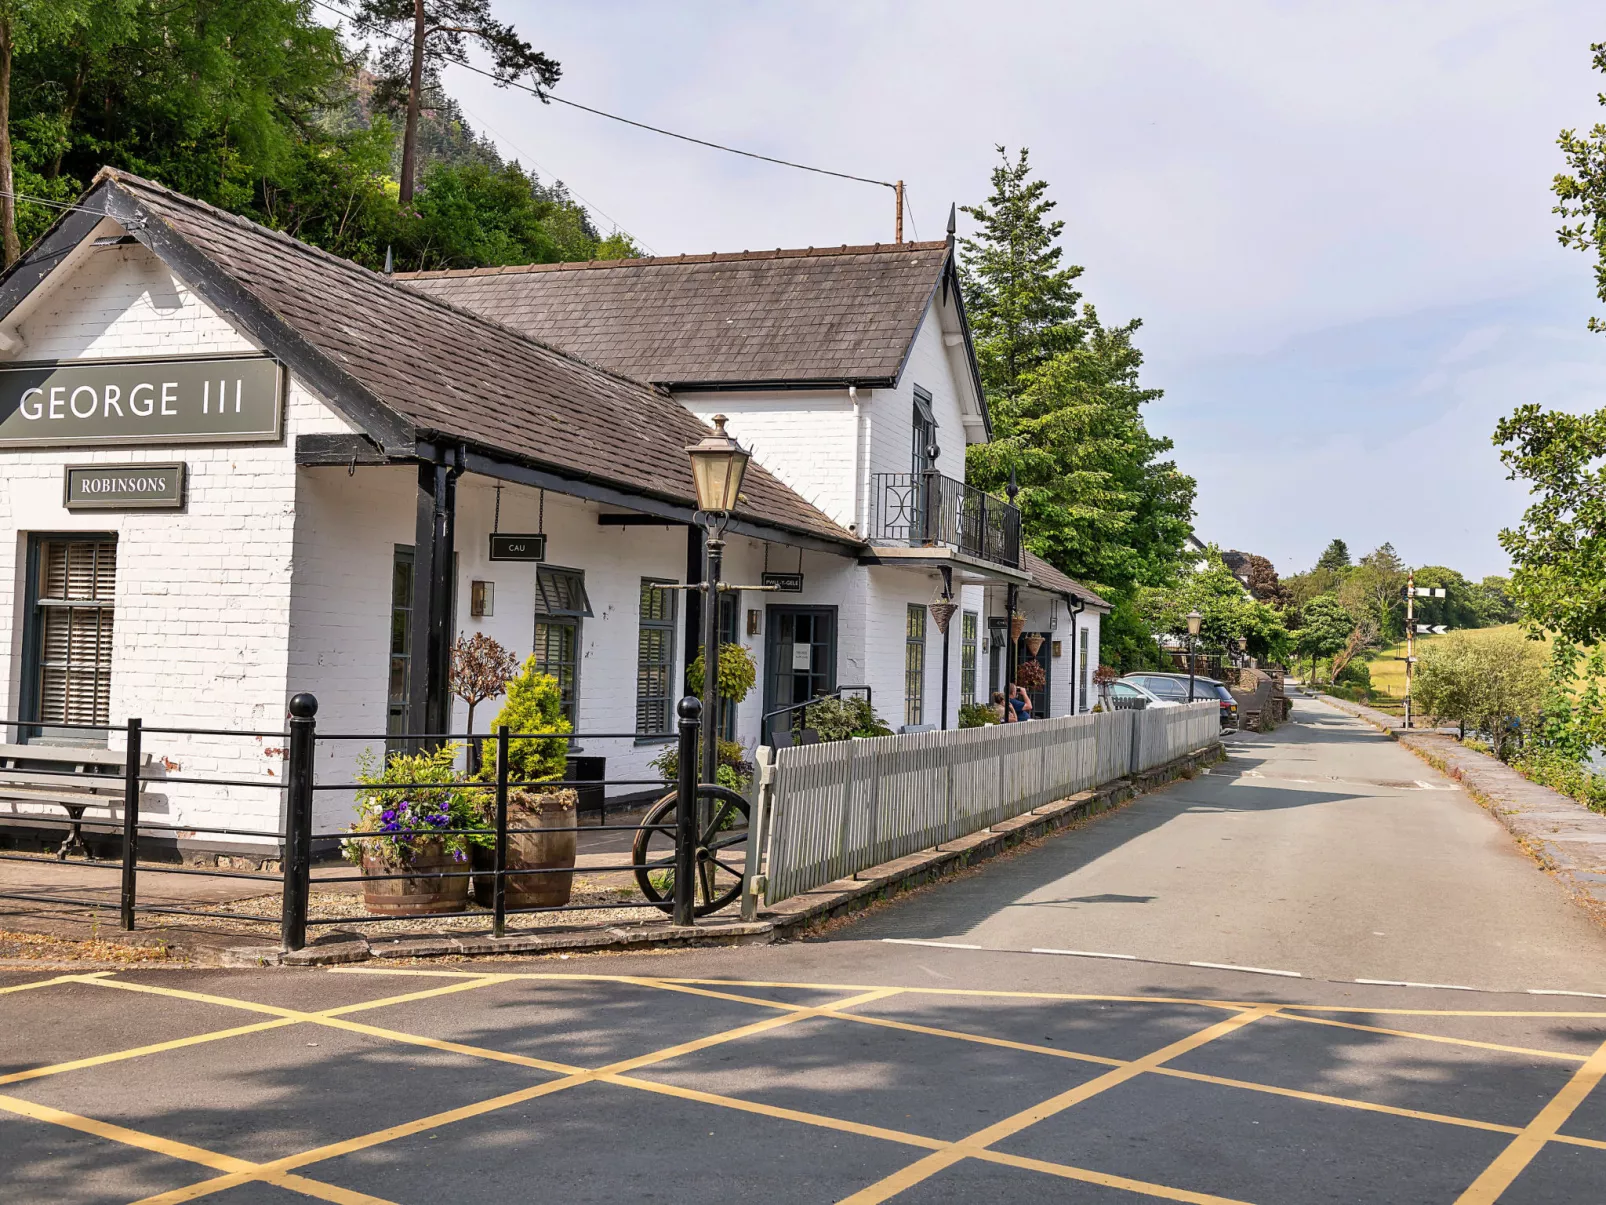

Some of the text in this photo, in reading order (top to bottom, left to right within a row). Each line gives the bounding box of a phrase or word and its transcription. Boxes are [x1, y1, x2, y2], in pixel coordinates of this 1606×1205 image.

[19, 379, 242, 421] GEORGE III
[81, 477, 167, 493] ROBINSONS
[508, 544, 526, 552] CAU
